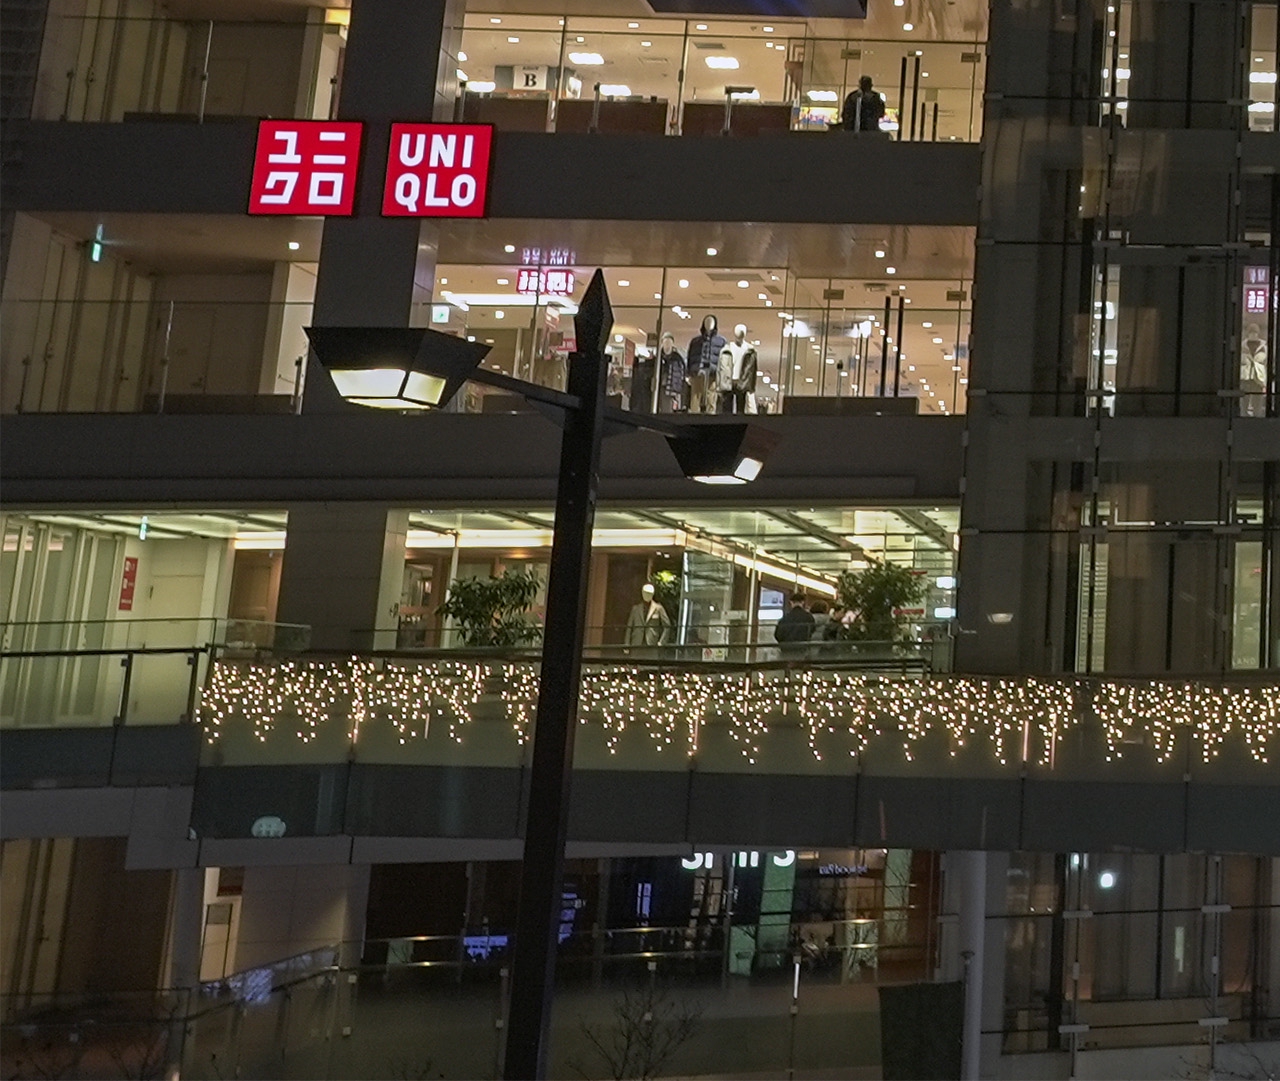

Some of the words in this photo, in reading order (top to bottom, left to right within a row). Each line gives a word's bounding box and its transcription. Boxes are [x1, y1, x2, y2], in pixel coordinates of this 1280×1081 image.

[523, 72, 537, 88] B
[399, 133, 474, 169] UNI
[394, 173, 477, 212] QLO
